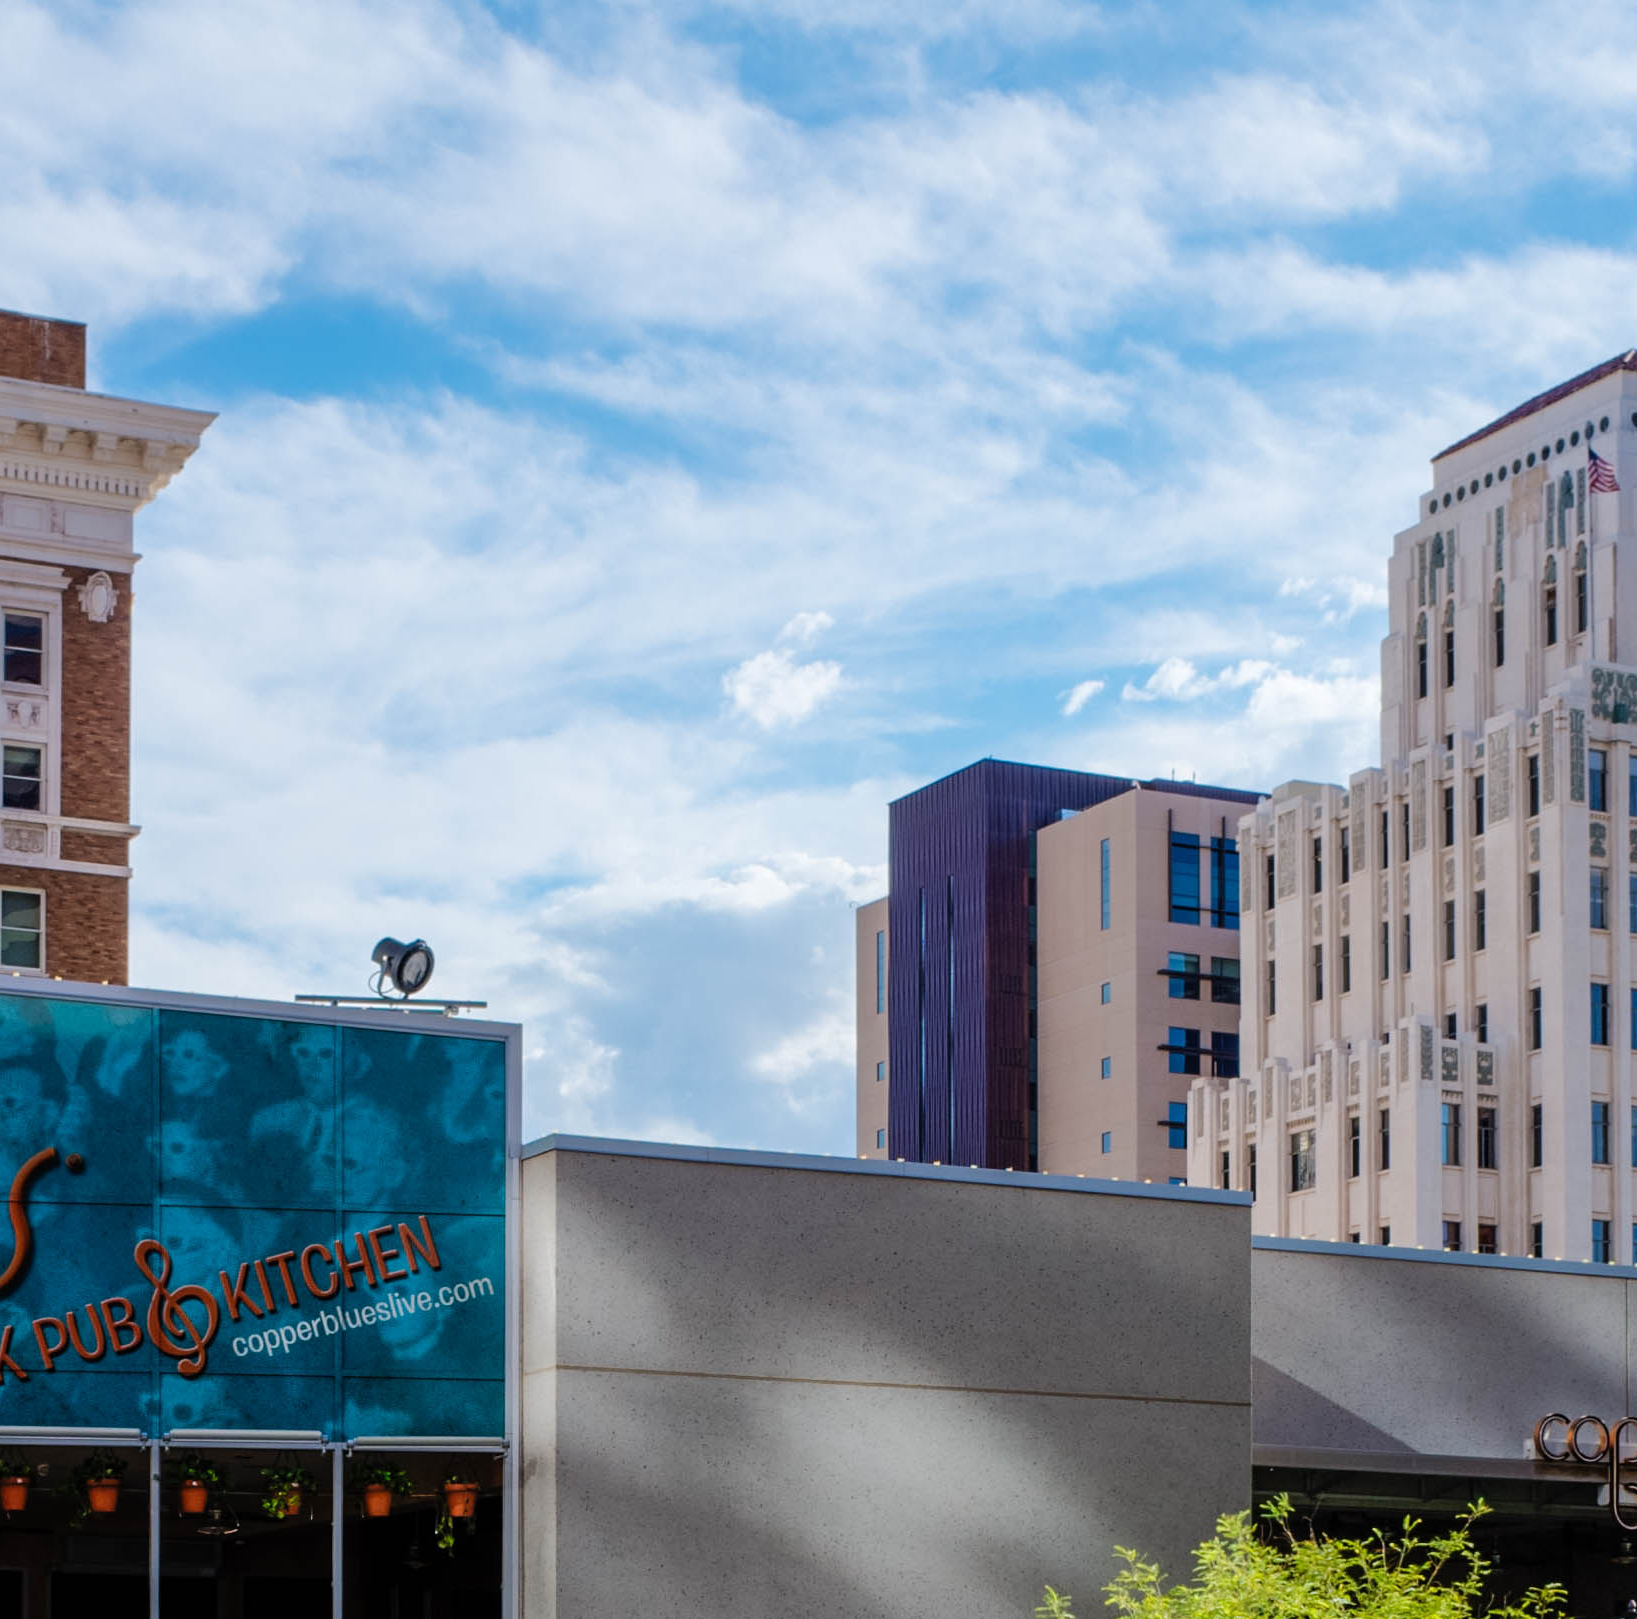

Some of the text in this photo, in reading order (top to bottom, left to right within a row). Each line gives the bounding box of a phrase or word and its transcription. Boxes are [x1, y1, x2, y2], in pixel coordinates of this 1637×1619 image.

[31, 1297, 142, 1371] PUB
[219, 1215, 443, 1323] KITCHEN
[231, 1272, 495, 1359] copperblueslive.com
